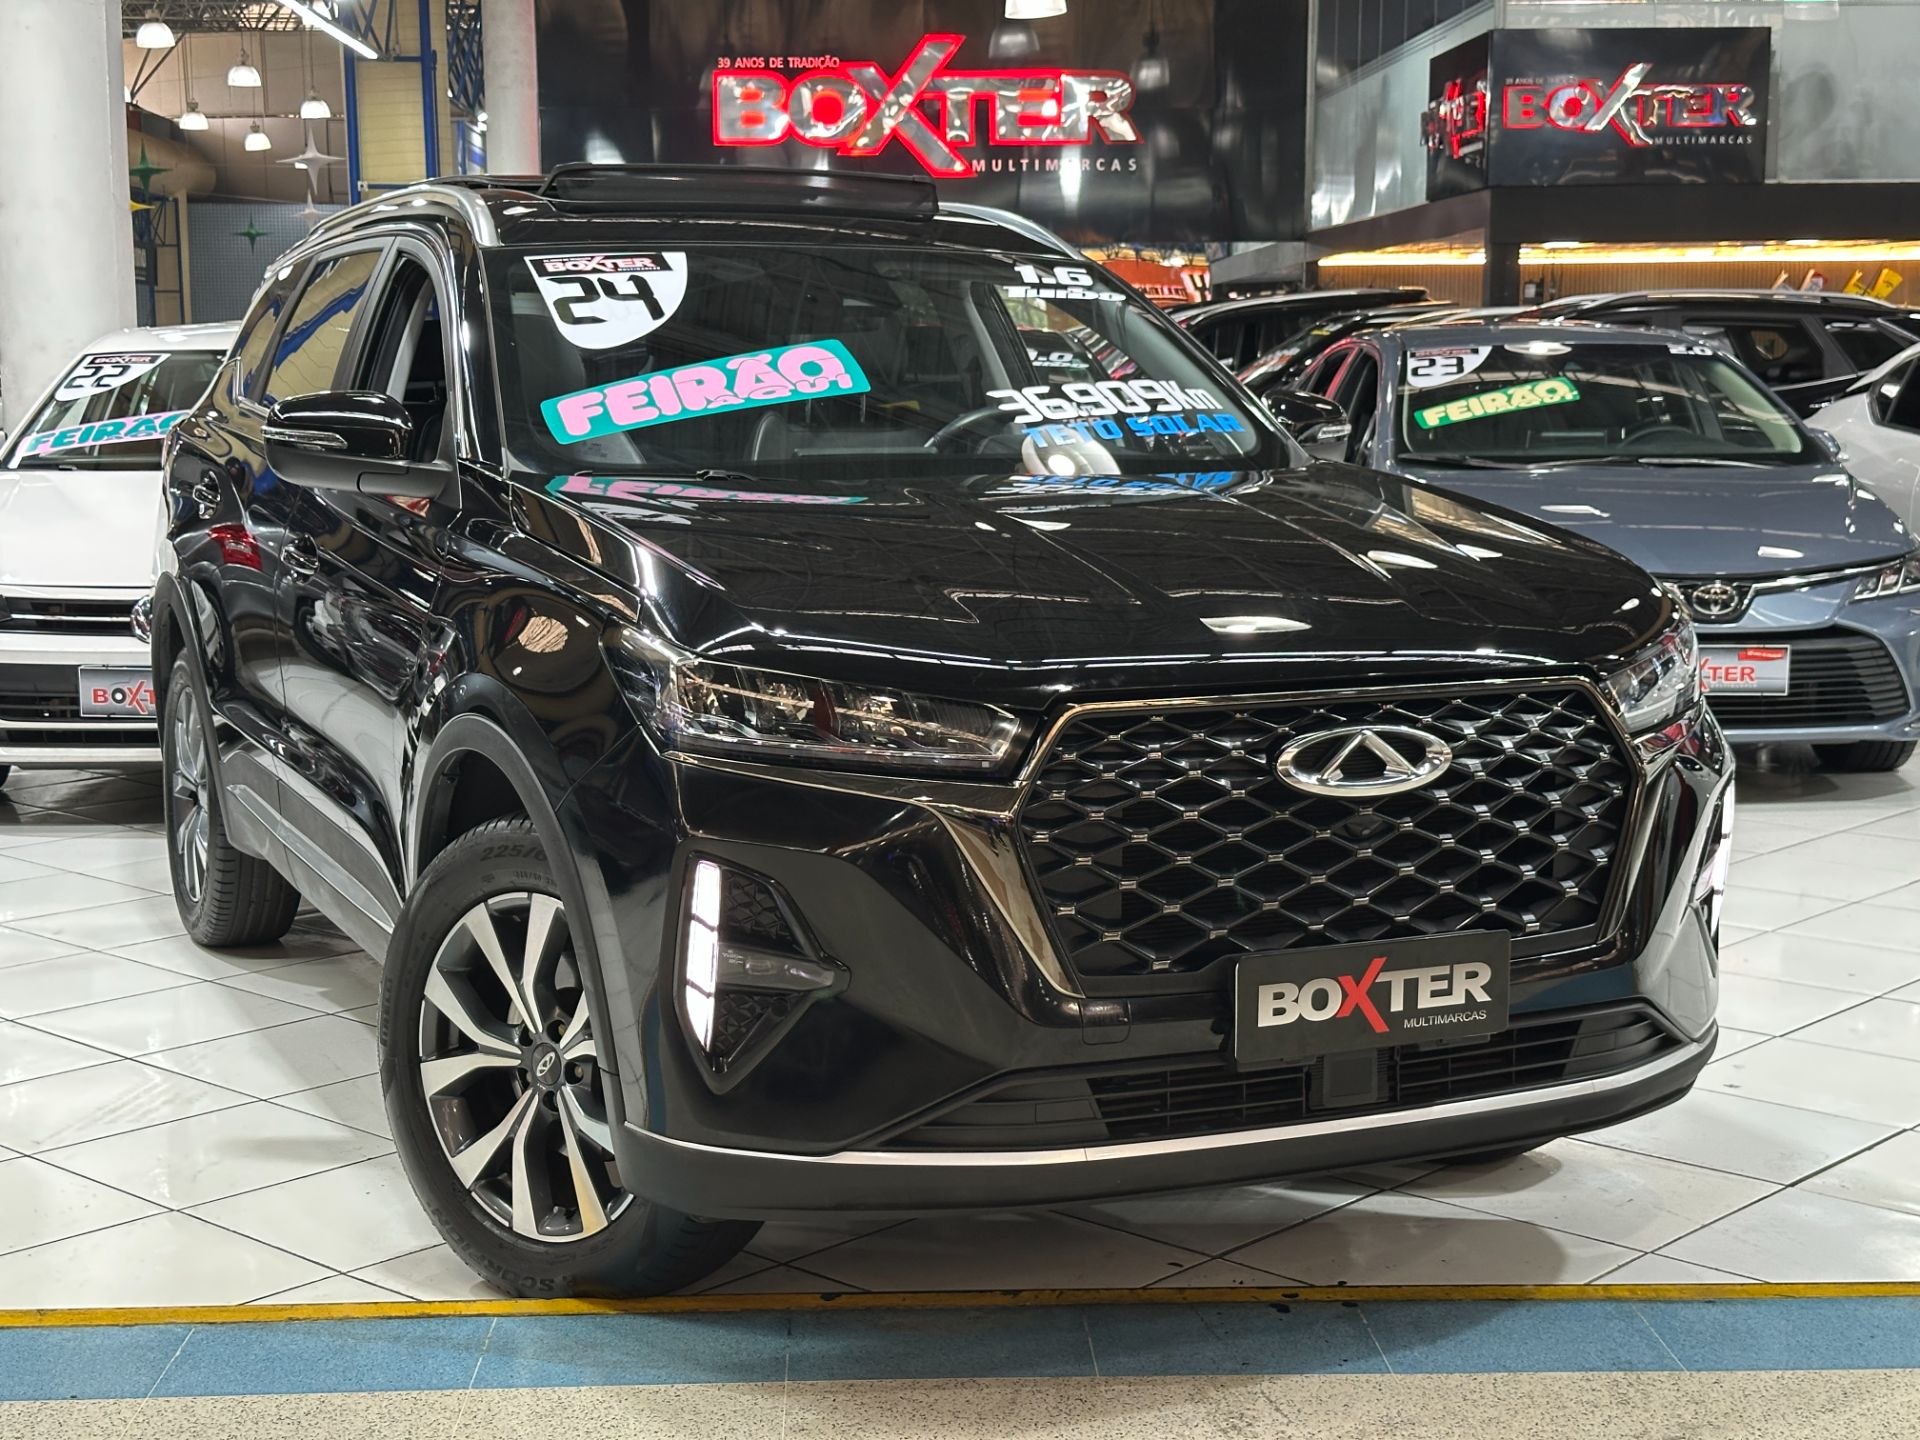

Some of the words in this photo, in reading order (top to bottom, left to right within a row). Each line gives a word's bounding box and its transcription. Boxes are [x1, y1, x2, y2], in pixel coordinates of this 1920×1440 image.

[717, 57, 731, 69] 39
[734, 57, 764, 69] ANOS
[769, 57, 784, 69] DE
[788, 55, 840, 70] TRADIÇÃO
[712, 34, 1144, 178] BOXTER
[1503, 63, 1757, 147] BOXTER
[1654, 135, 1753, 145] MULTIMARCAS
[972, 158, 1137, 172] MULTIMRCAS
[543, 255, 658, 273] BOXTER
[1013, 264, 1094, 287] 1.6
[545, 274, 666, 326] 24
[94, 354, 152, 364] BOXTER
[1410, 356, 1465, 377] 23
[63, 364, 131, 389] 22
[556, 346, 848, 436] FEIRÃO
[1422, 380, 1571, 427] FEIRÃO
[1021, 418, 1123, 449] TETO
[1125, 413, 1246, 438] SOLAR
[1257, 956, 1493, 1033] BOXTER
[1403, 1009, 1488, 1029] MULTIMARCAS
